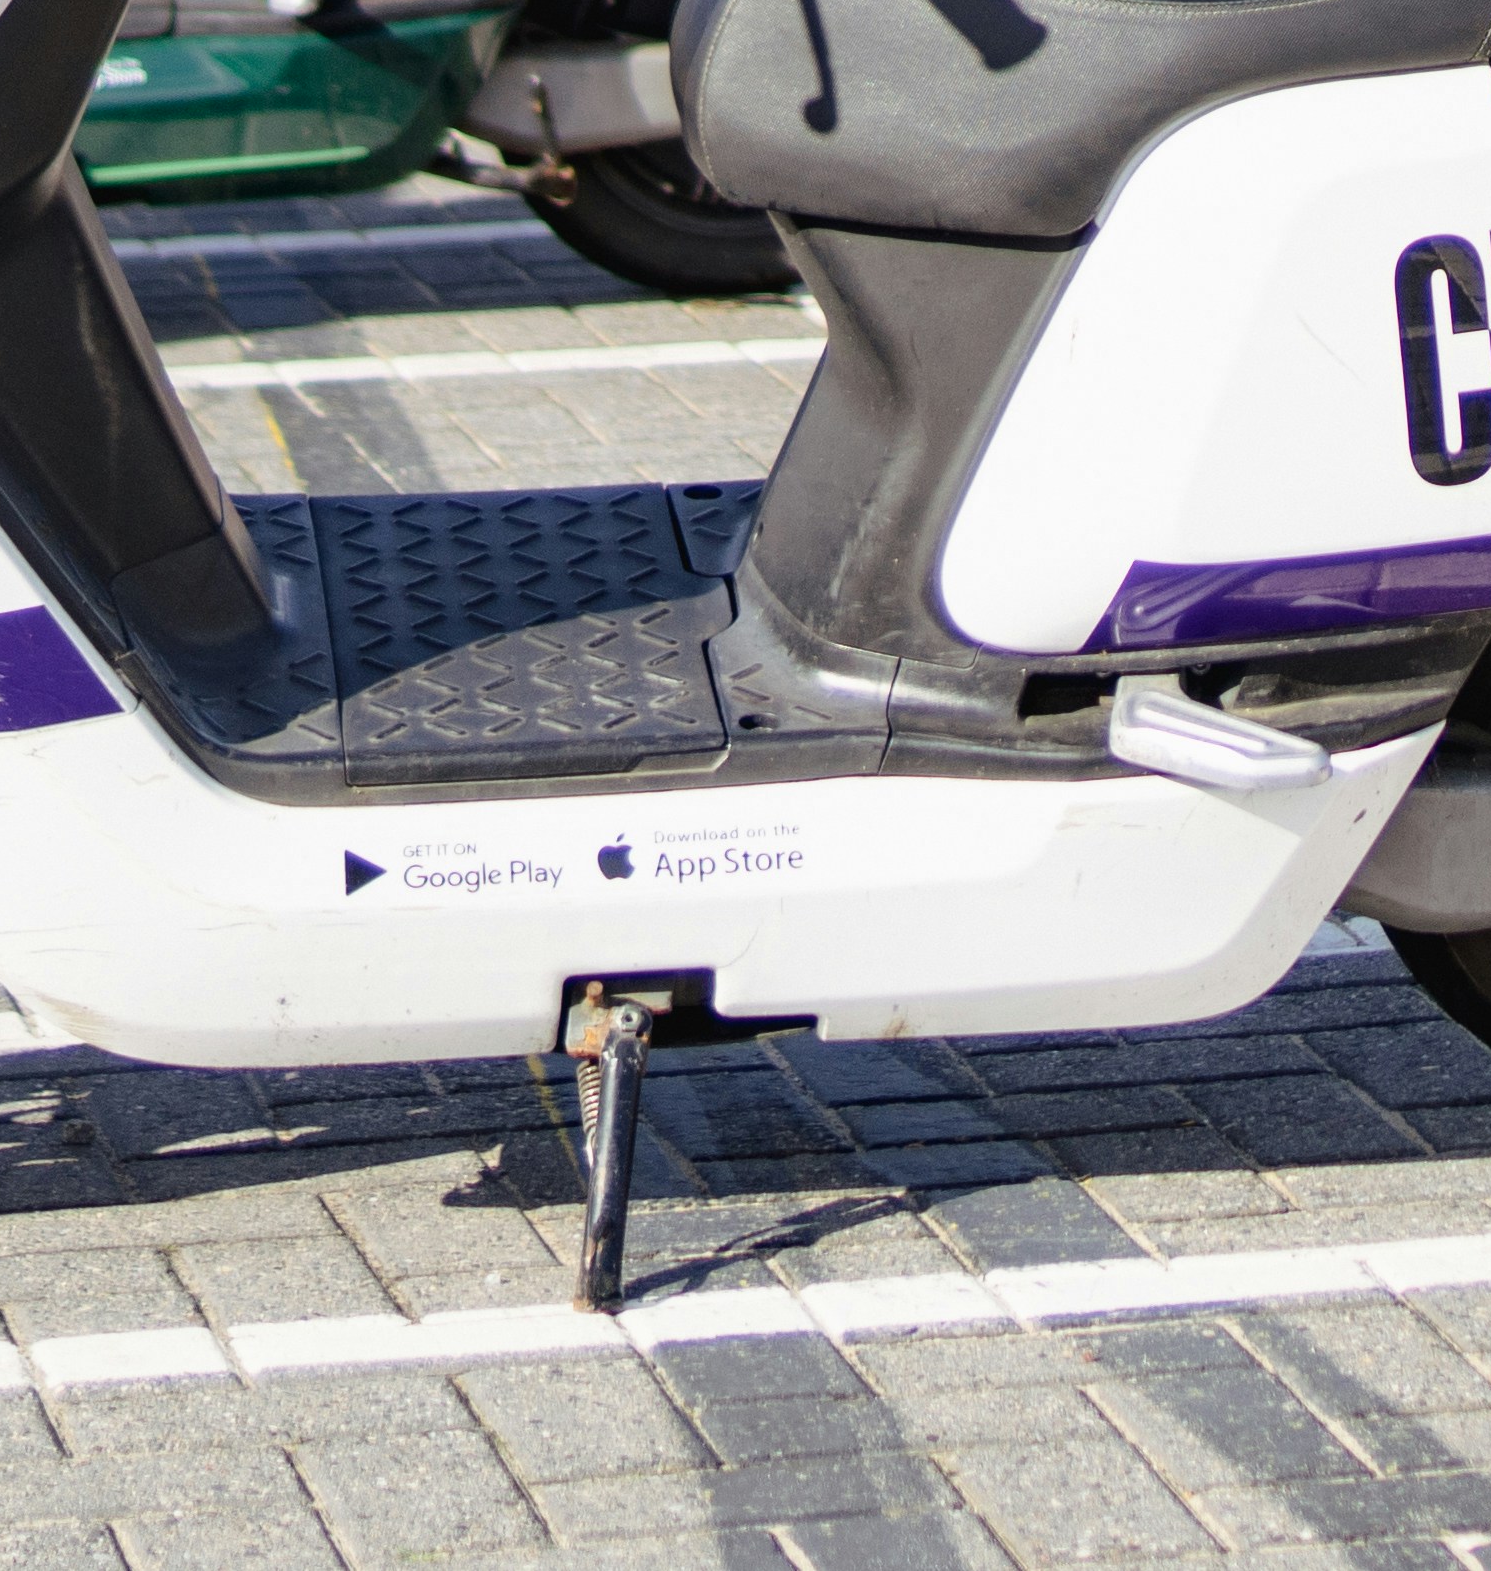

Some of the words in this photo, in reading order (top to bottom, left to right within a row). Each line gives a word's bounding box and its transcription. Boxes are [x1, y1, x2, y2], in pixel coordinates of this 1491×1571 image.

[654, 827, 739, 844] Download
[746, 827, 767, 839] on
[774, 823, 801, 836] the
[403, 844, 432, 858] GET
[437, 844, 448, 857] IT
[453, 843, 477, 855] ON
[403, 862, 502, 893] Google
[510, 860, 563, 889] Play
[654, 852, 717, 884] App
[724, 848, 804, 874] Store
